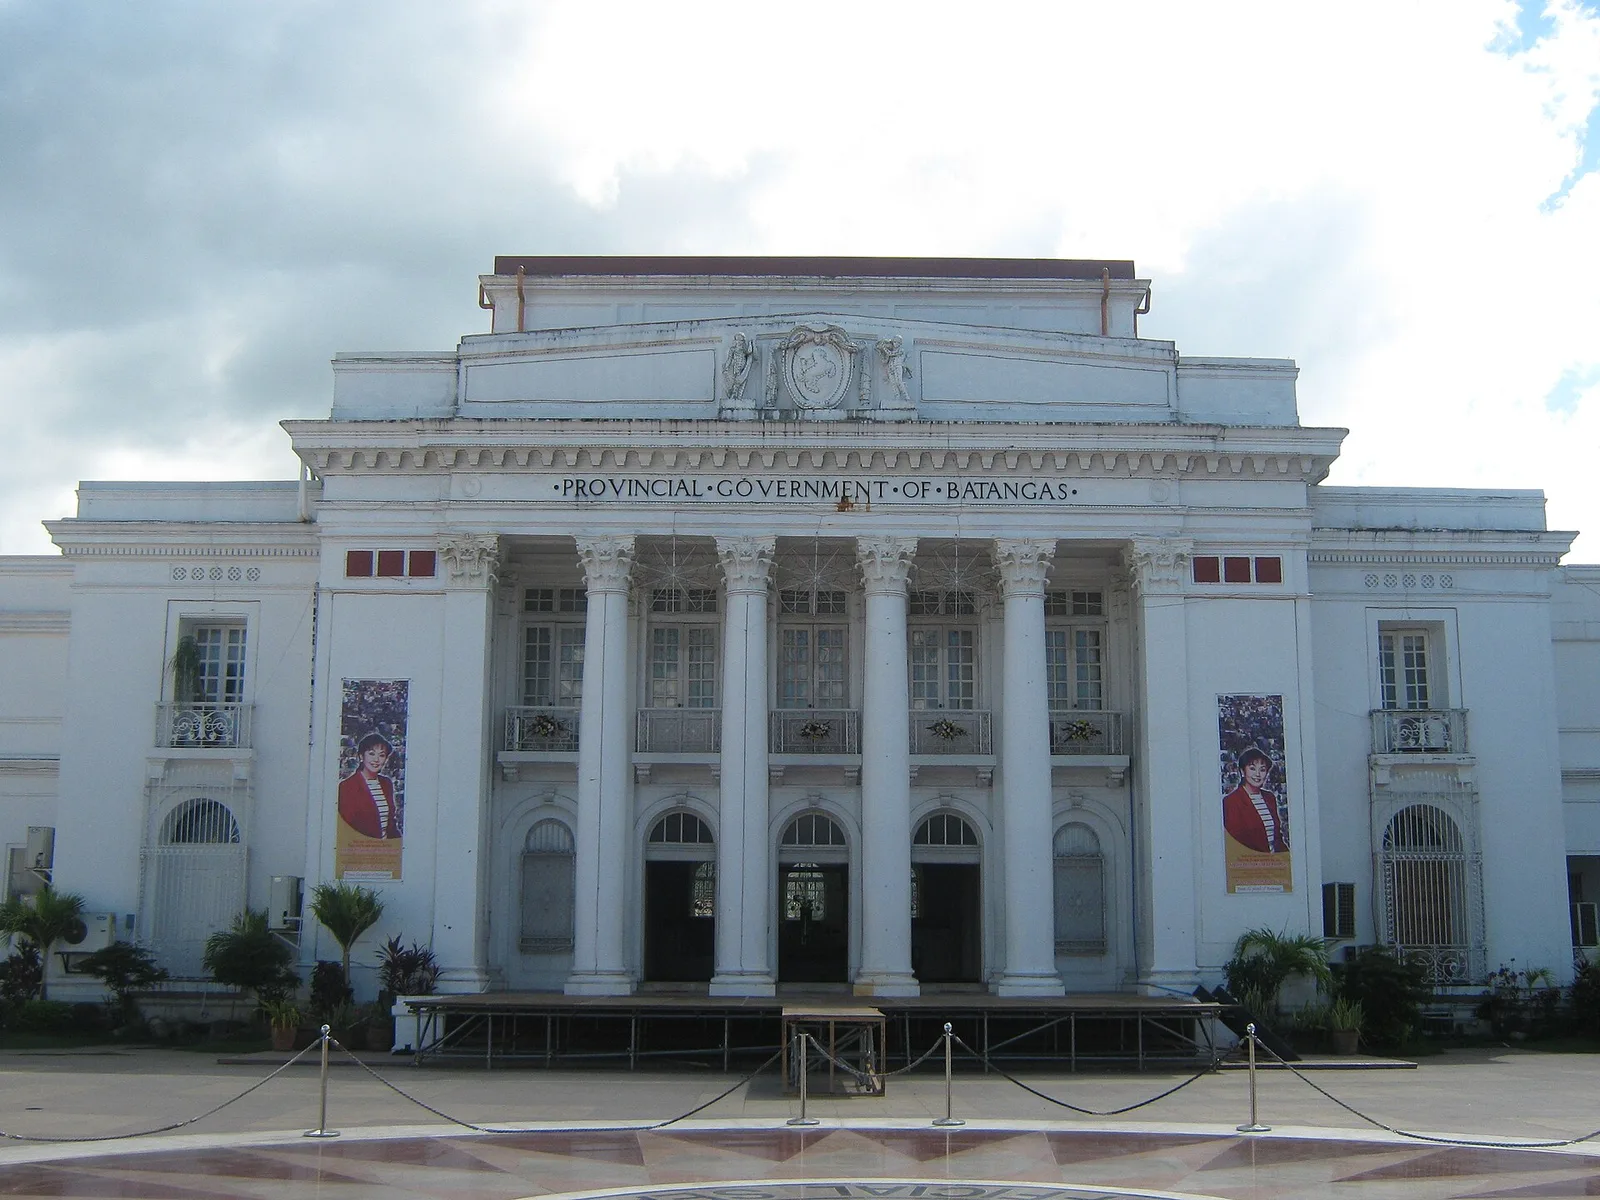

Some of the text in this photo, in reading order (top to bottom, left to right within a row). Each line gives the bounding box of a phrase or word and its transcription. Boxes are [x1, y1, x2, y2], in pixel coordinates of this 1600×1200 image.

[562, 478, 1068, 501] PROVINCIAL GOVERNMENT OF BATANGAS
